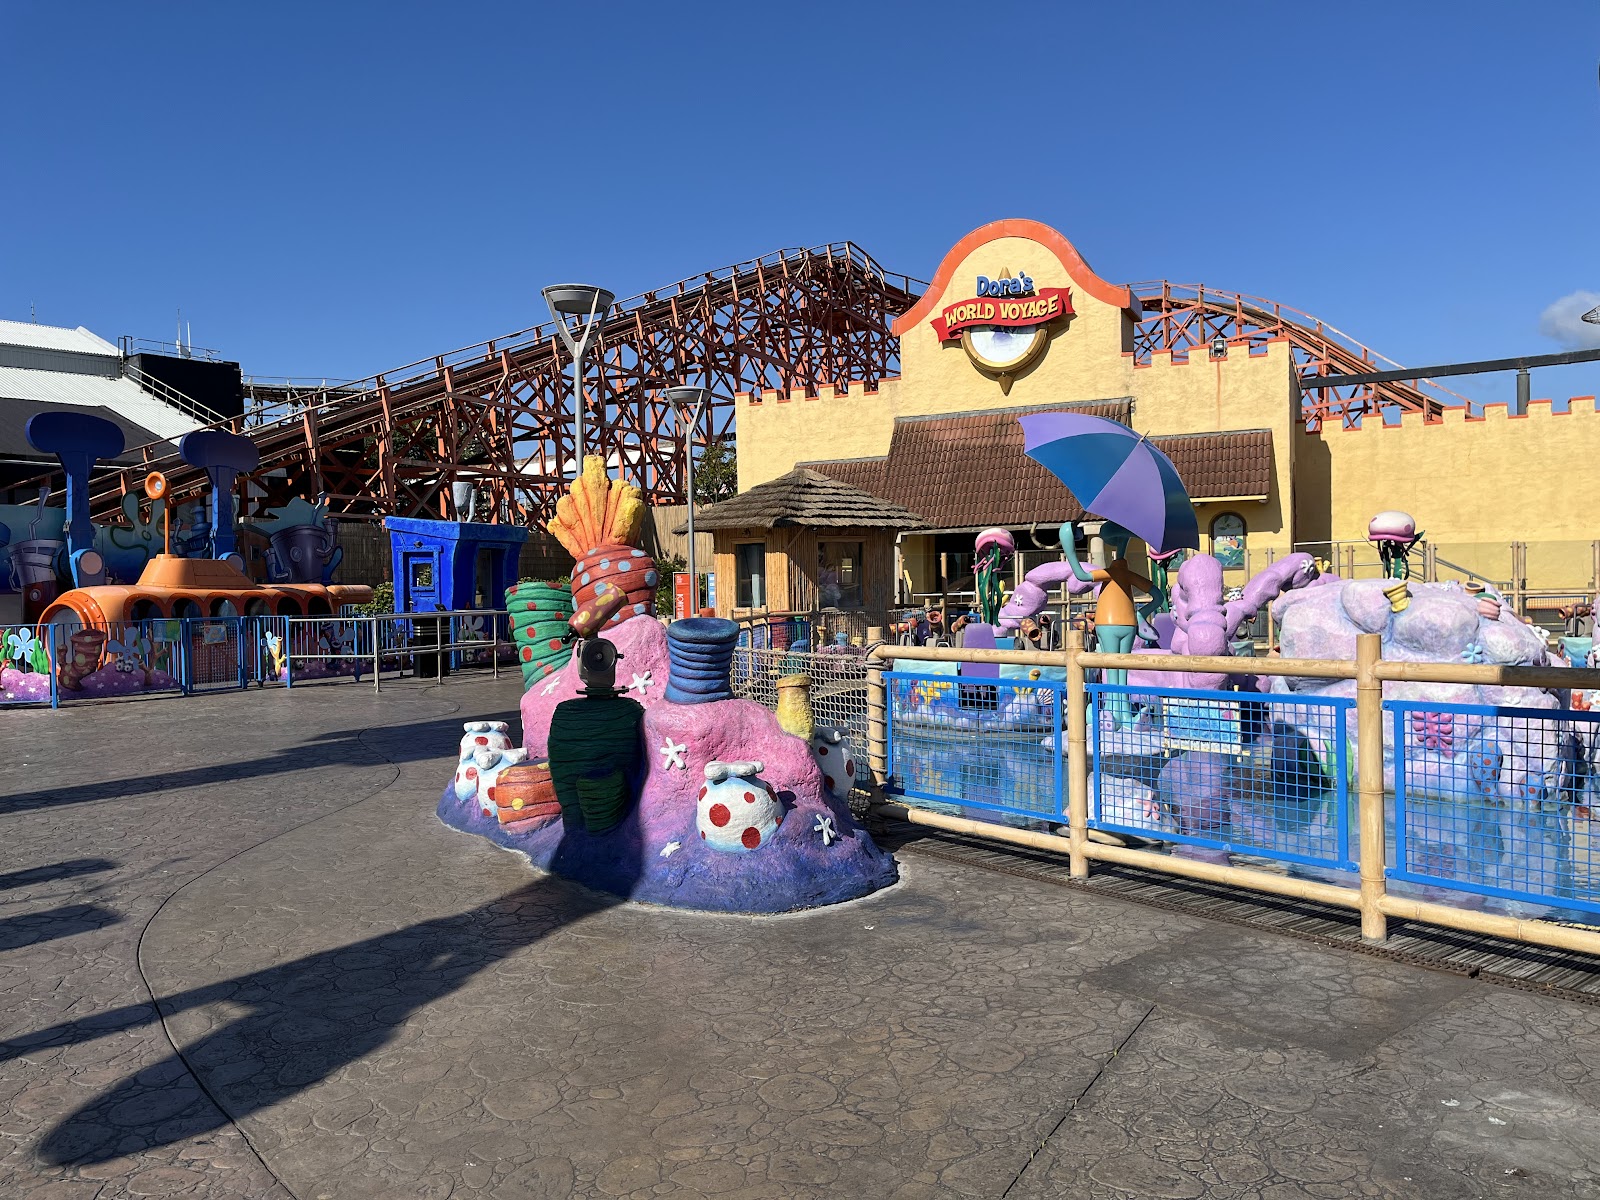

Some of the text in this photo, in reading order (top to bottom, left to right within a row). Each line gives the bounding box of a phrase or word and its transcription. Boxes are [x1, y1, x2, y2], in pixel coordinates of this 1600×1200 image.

[976, 271, 1034, 297] Dora's
[944, 294, 1059, 328] WORLD VOYAGE
